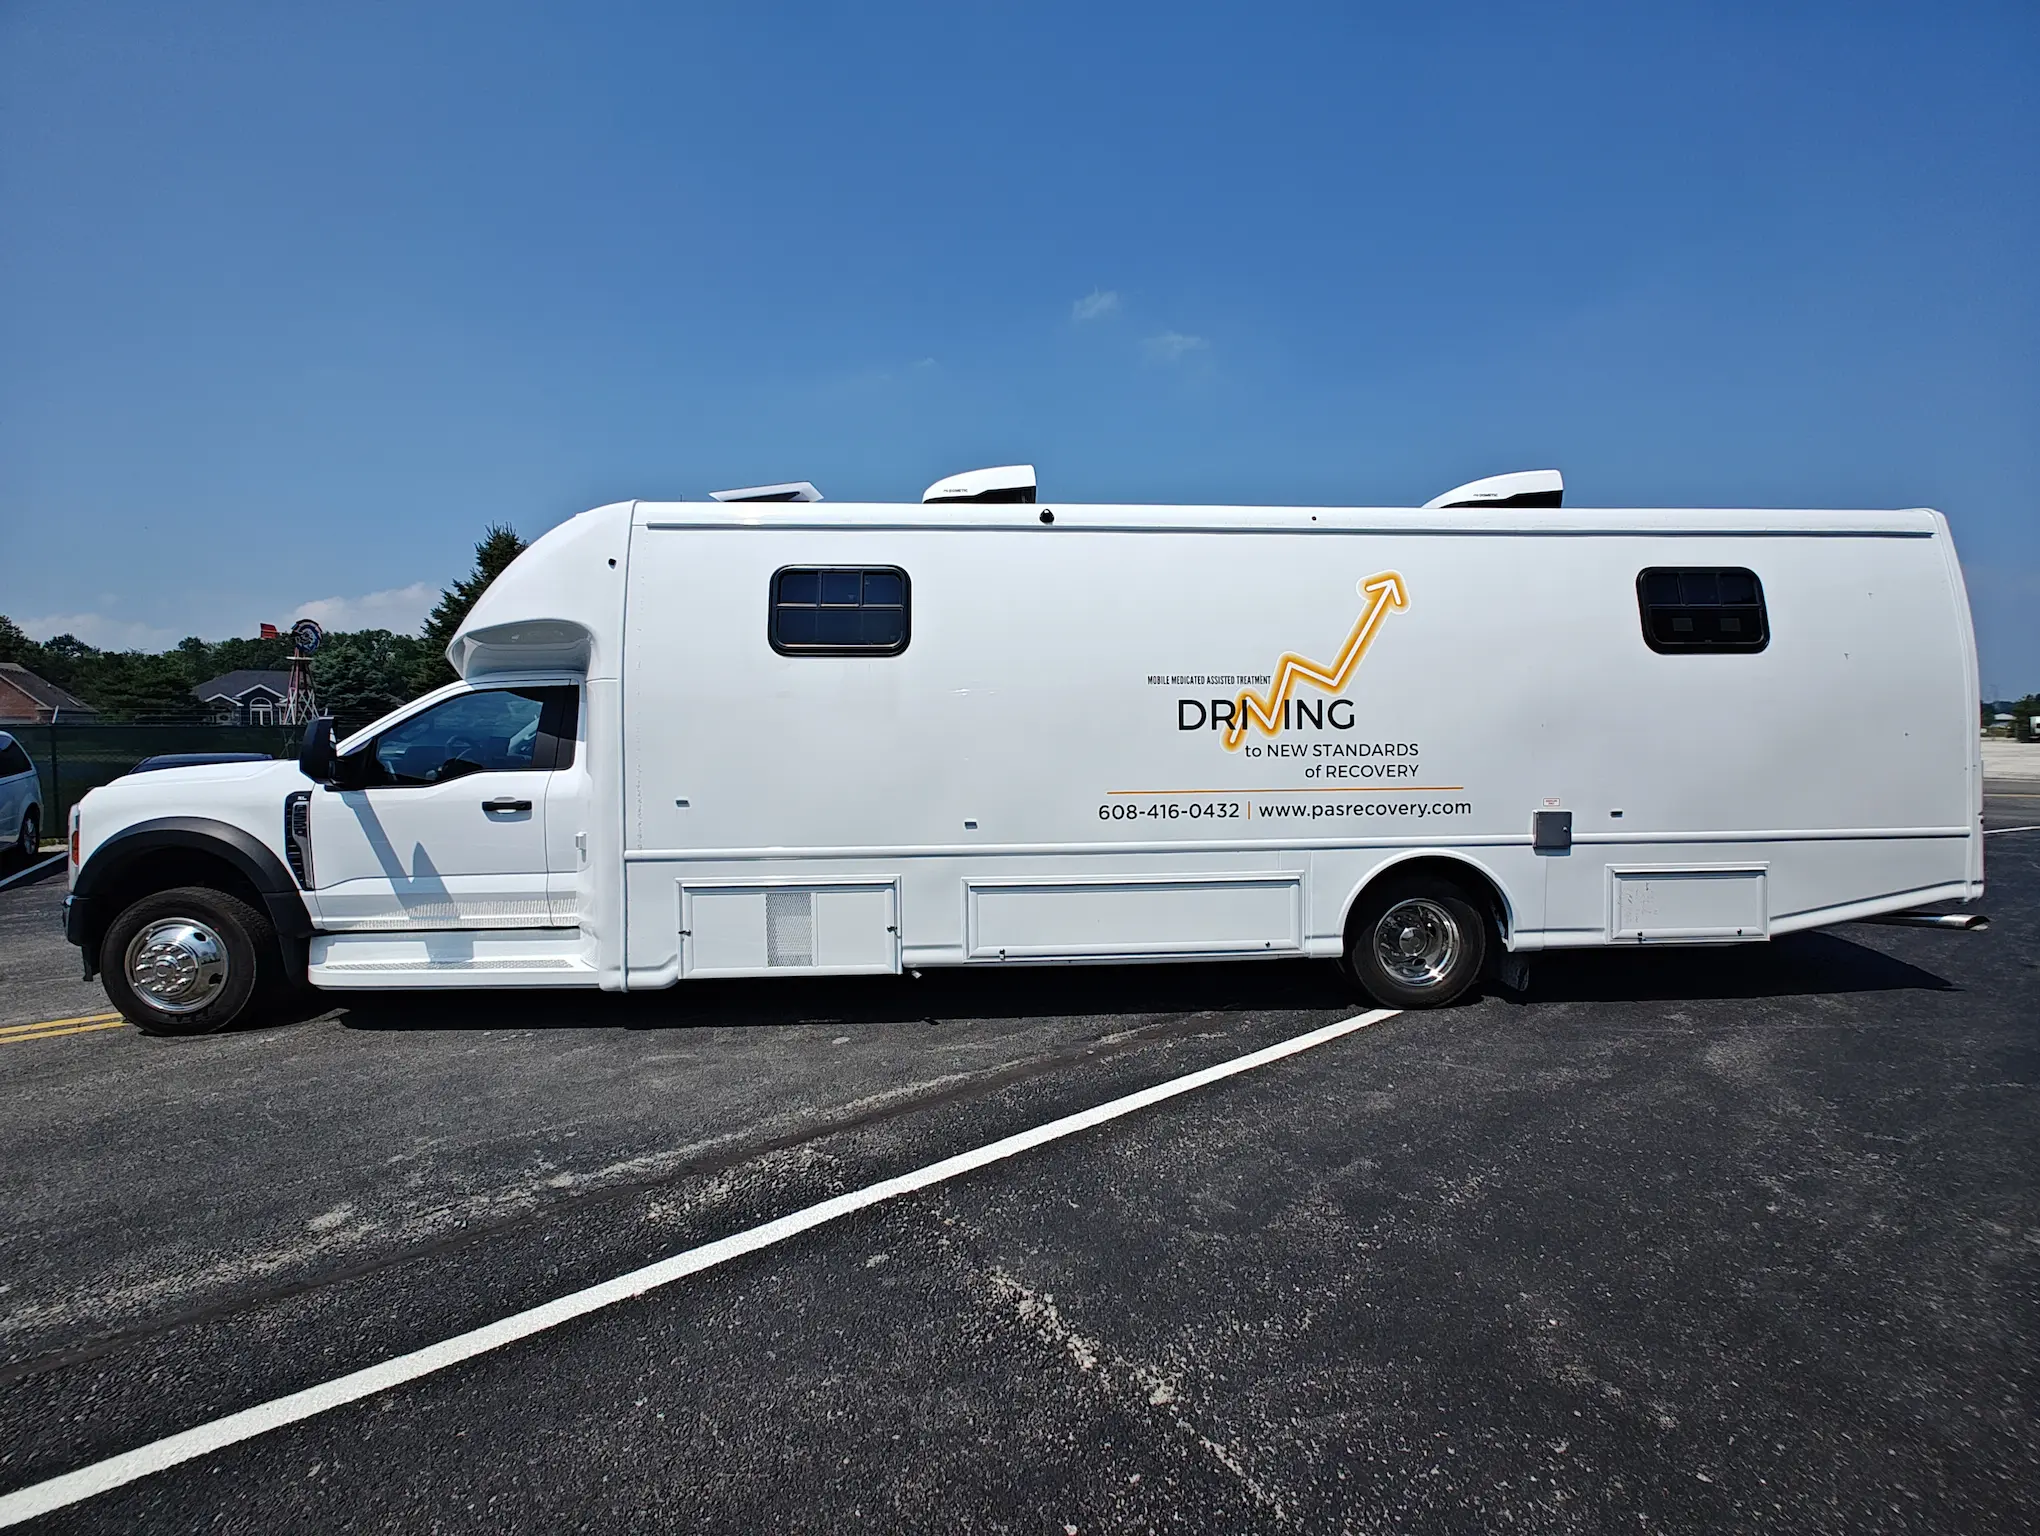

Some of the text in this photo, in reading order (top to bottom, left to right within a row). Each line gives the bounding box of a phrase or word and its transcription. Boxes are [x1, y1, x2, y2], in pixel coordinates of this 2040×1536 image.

[1147, 675, 1271, 685] MOBILE MEDICATED ASSISTED TREATMENT
[1178, 699, 1355, 731] DRIVING
[1244, 743, 1419, 758] to NEW STANDARDS
[1305, 764, 1419, 779] of RECOVERY
[1098, 801, 1472, 820] 608-416-0432 www.pasrecovery.com
